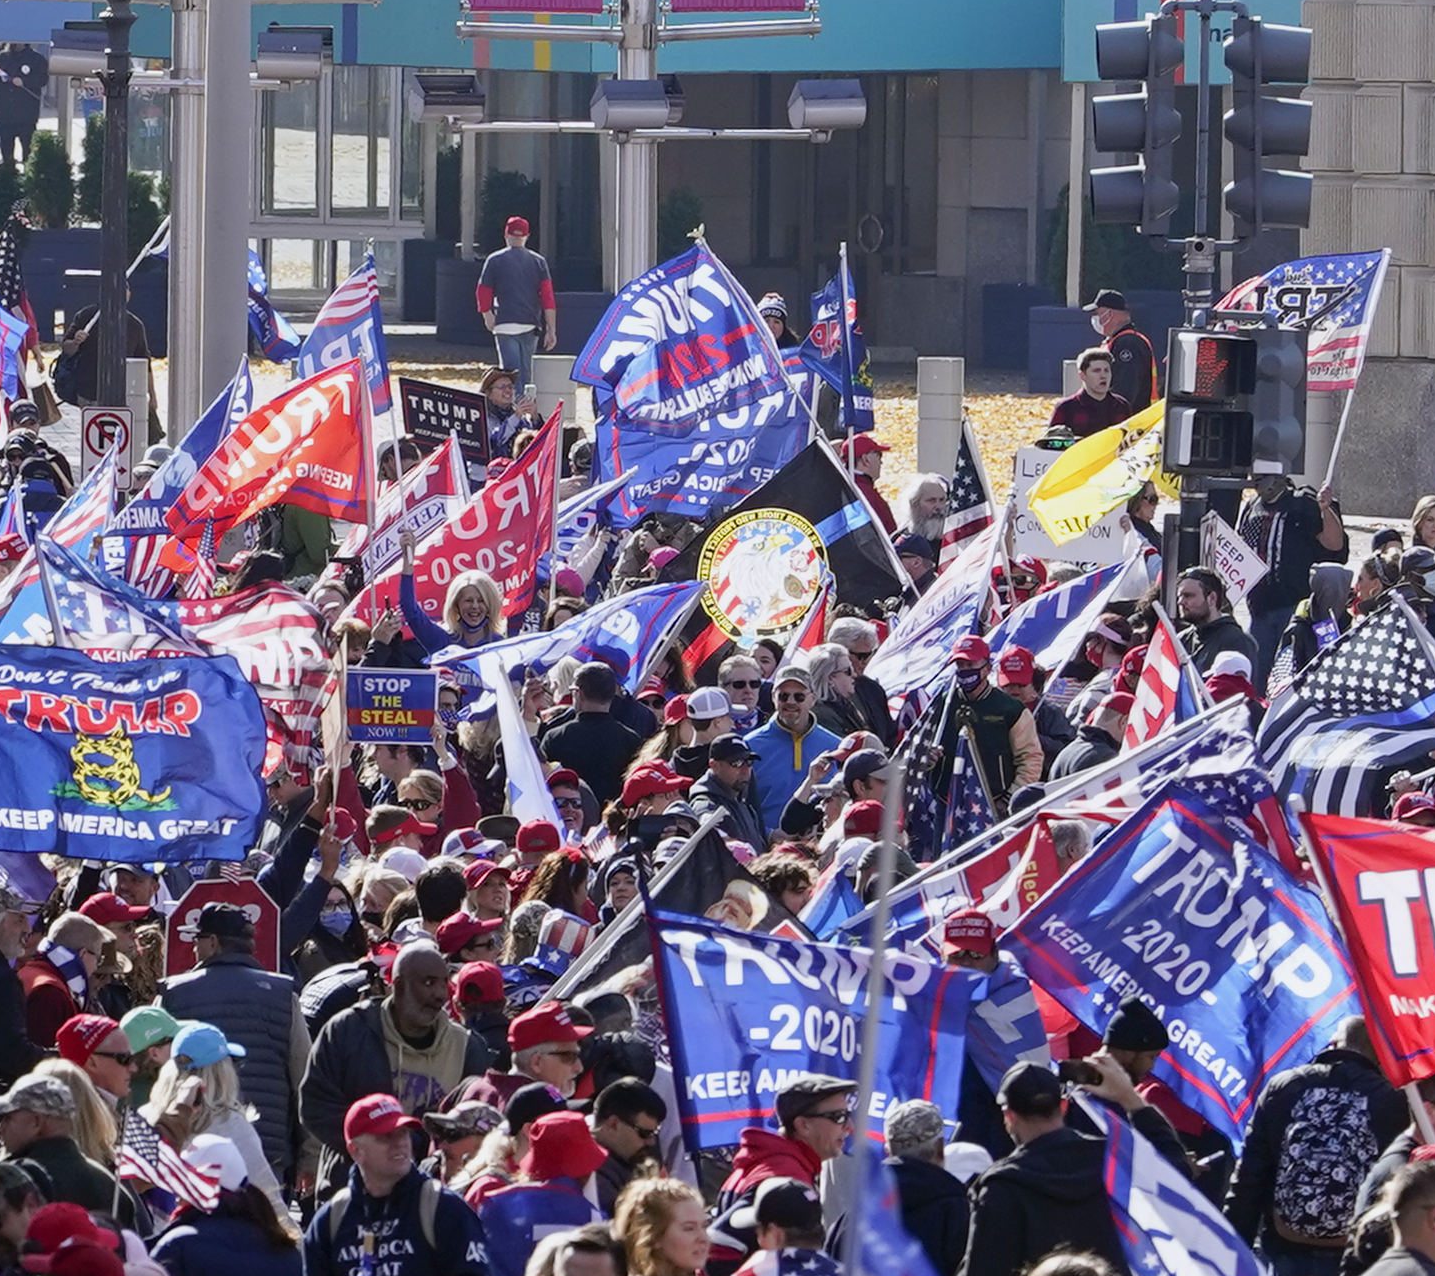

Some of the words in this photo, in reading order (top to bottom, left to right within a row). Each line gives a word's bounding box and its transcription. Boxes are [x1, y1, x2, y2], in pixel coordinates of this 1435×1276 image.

[407, 395, 483, 422] TRUMP
[417, 412, 475, 435] PENCE
[1215, 534, 1244, 563] KEEP
[363, 678, 412, 693] STOP
[372, 695, 402, 707] THE
[360, 709, 418, 725] STEAL
[368, 727, 395, 738] NOW
[158, 818, 239, 840] GREAT
[1131, 821, 1332, 1000] TRUMP
[660, 930, 932, 1013] TRUMP
[1038, 912, 1091, 967] KEEP
[1166, 1015, 1249, 1098] GREAT!
[685, 1074, 751, 1102] KEEP
